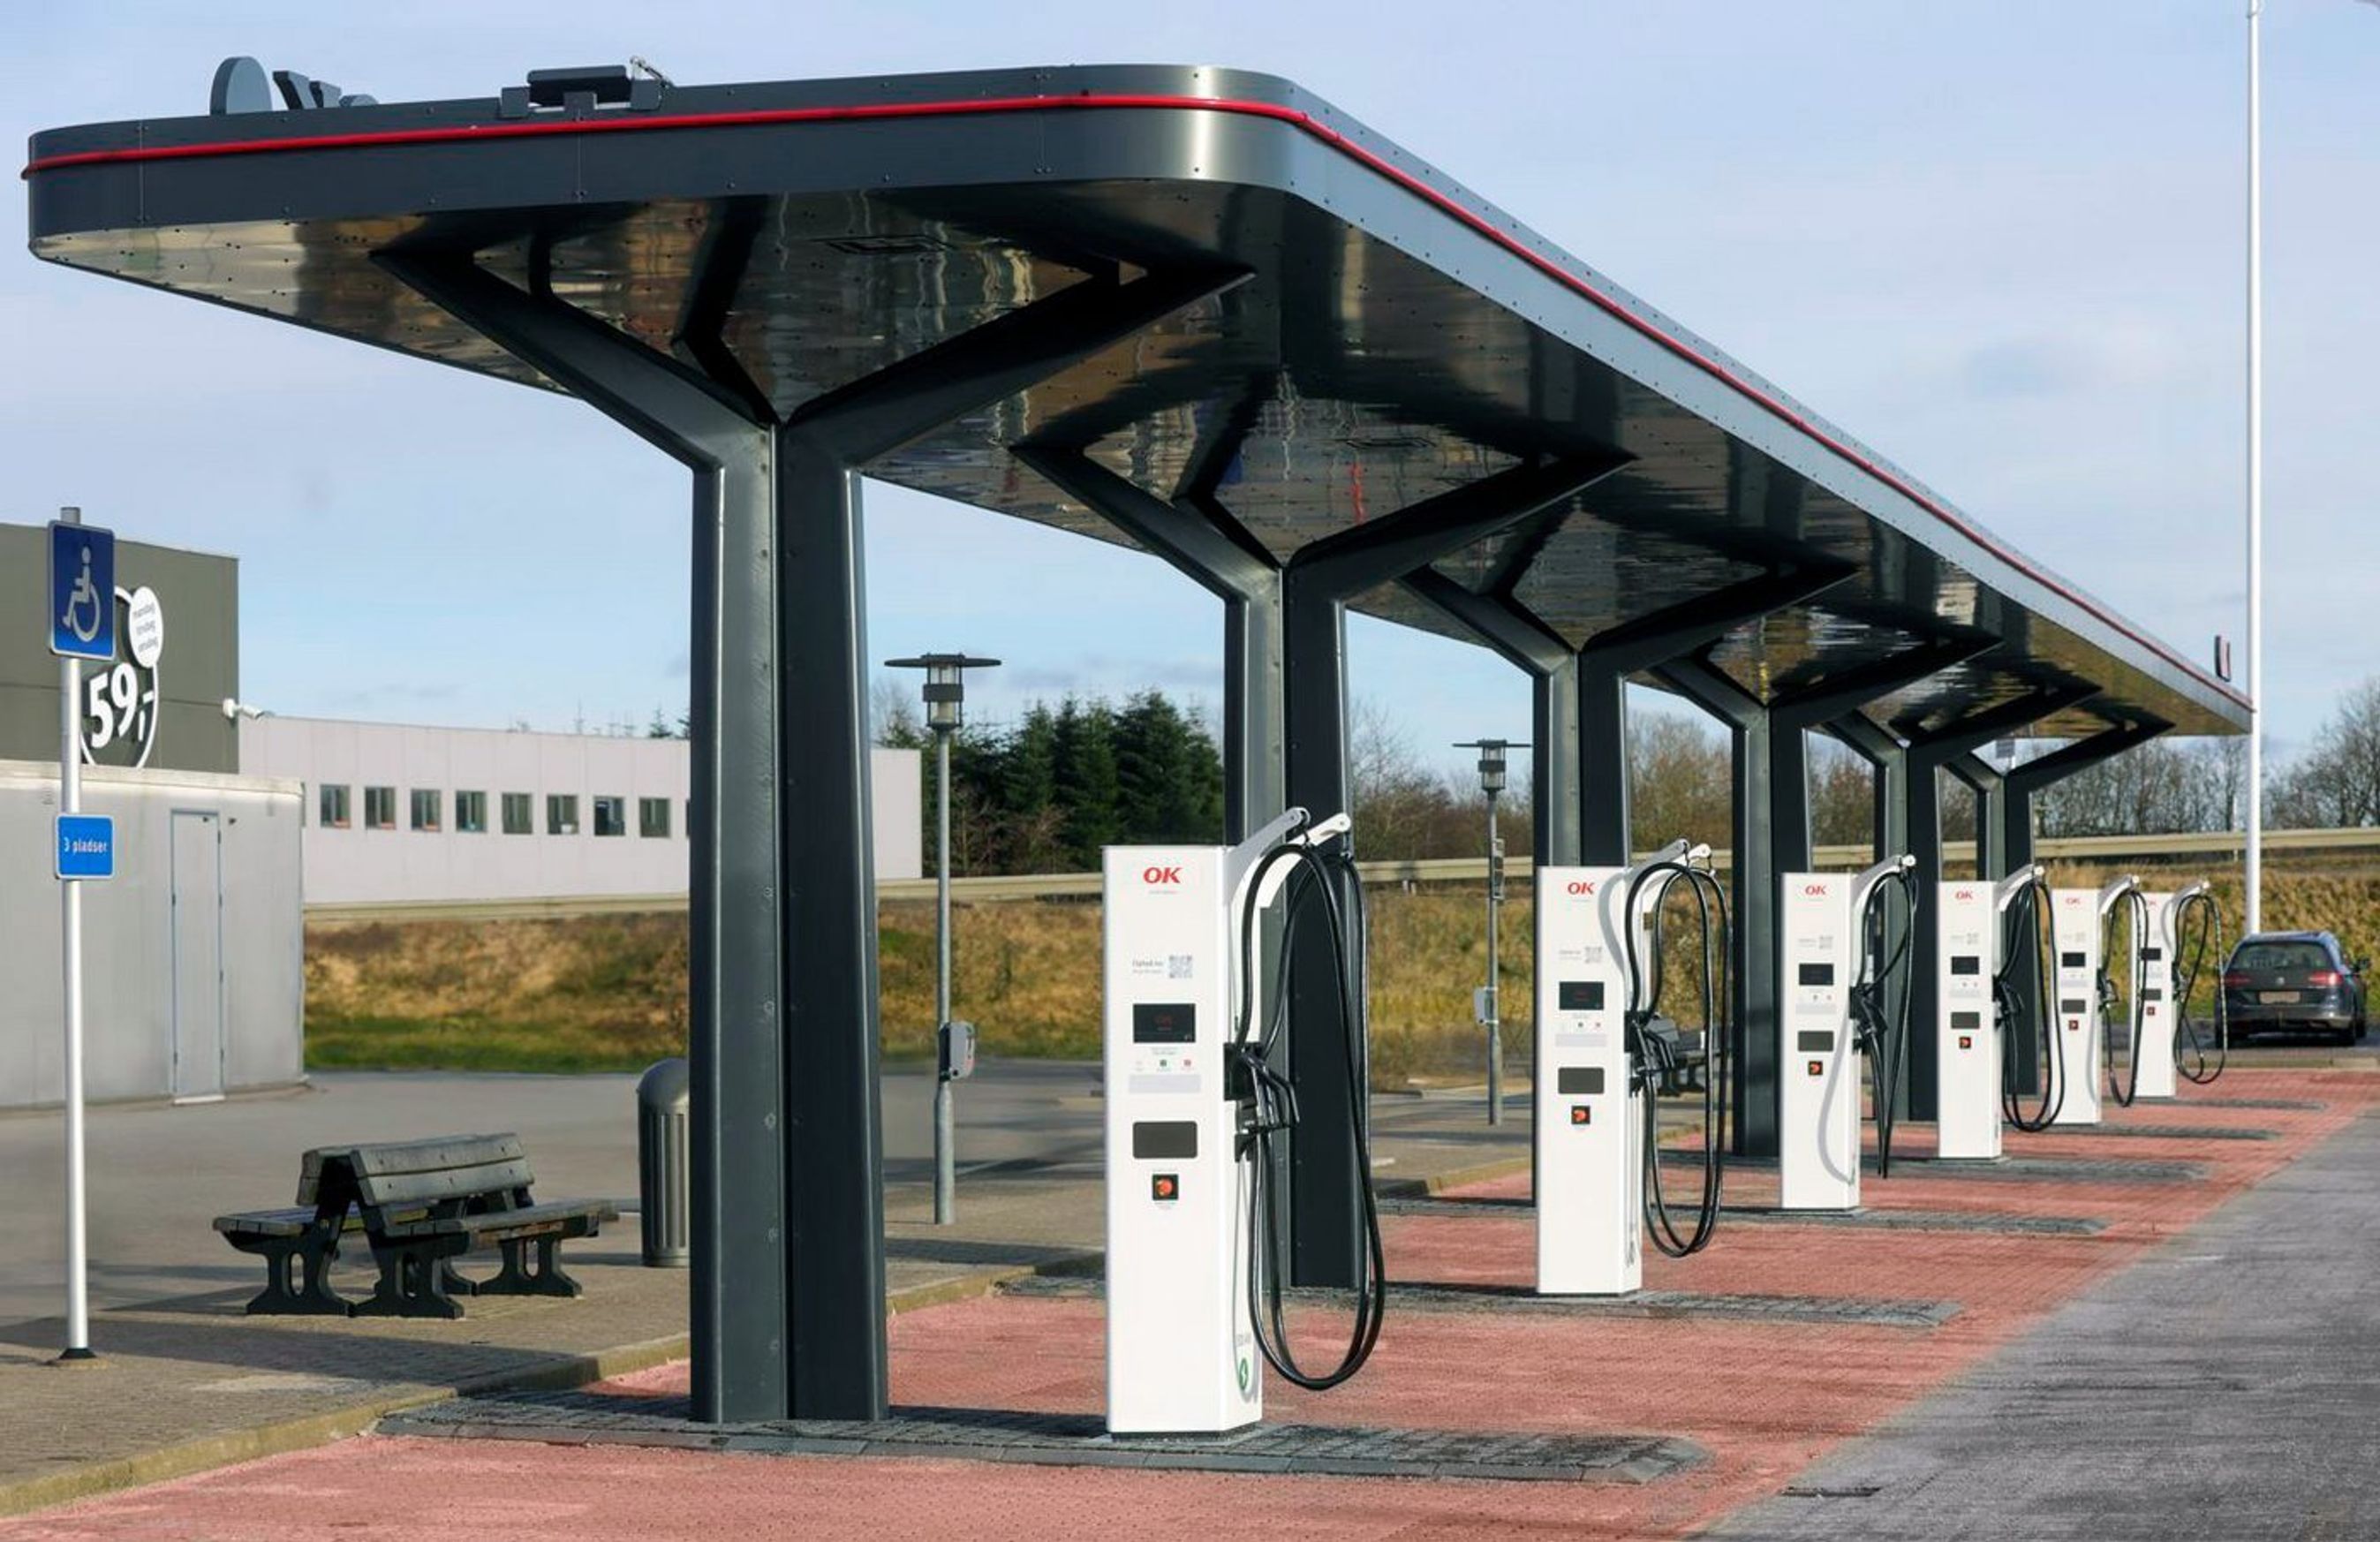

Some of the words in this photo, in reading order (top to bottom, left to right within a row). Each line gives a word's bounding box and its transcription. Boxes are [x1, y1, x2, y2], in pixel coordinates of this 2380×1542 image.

[64, 836, 70, 853] 3
[72, 837, 107, 856] pladser
[1143, 866, 1183, 884] OK
[1568, 881, 1595, 896] OK
[1805, 884, 1827, 896] OK
[1955, 890, 1974, 900] OK
